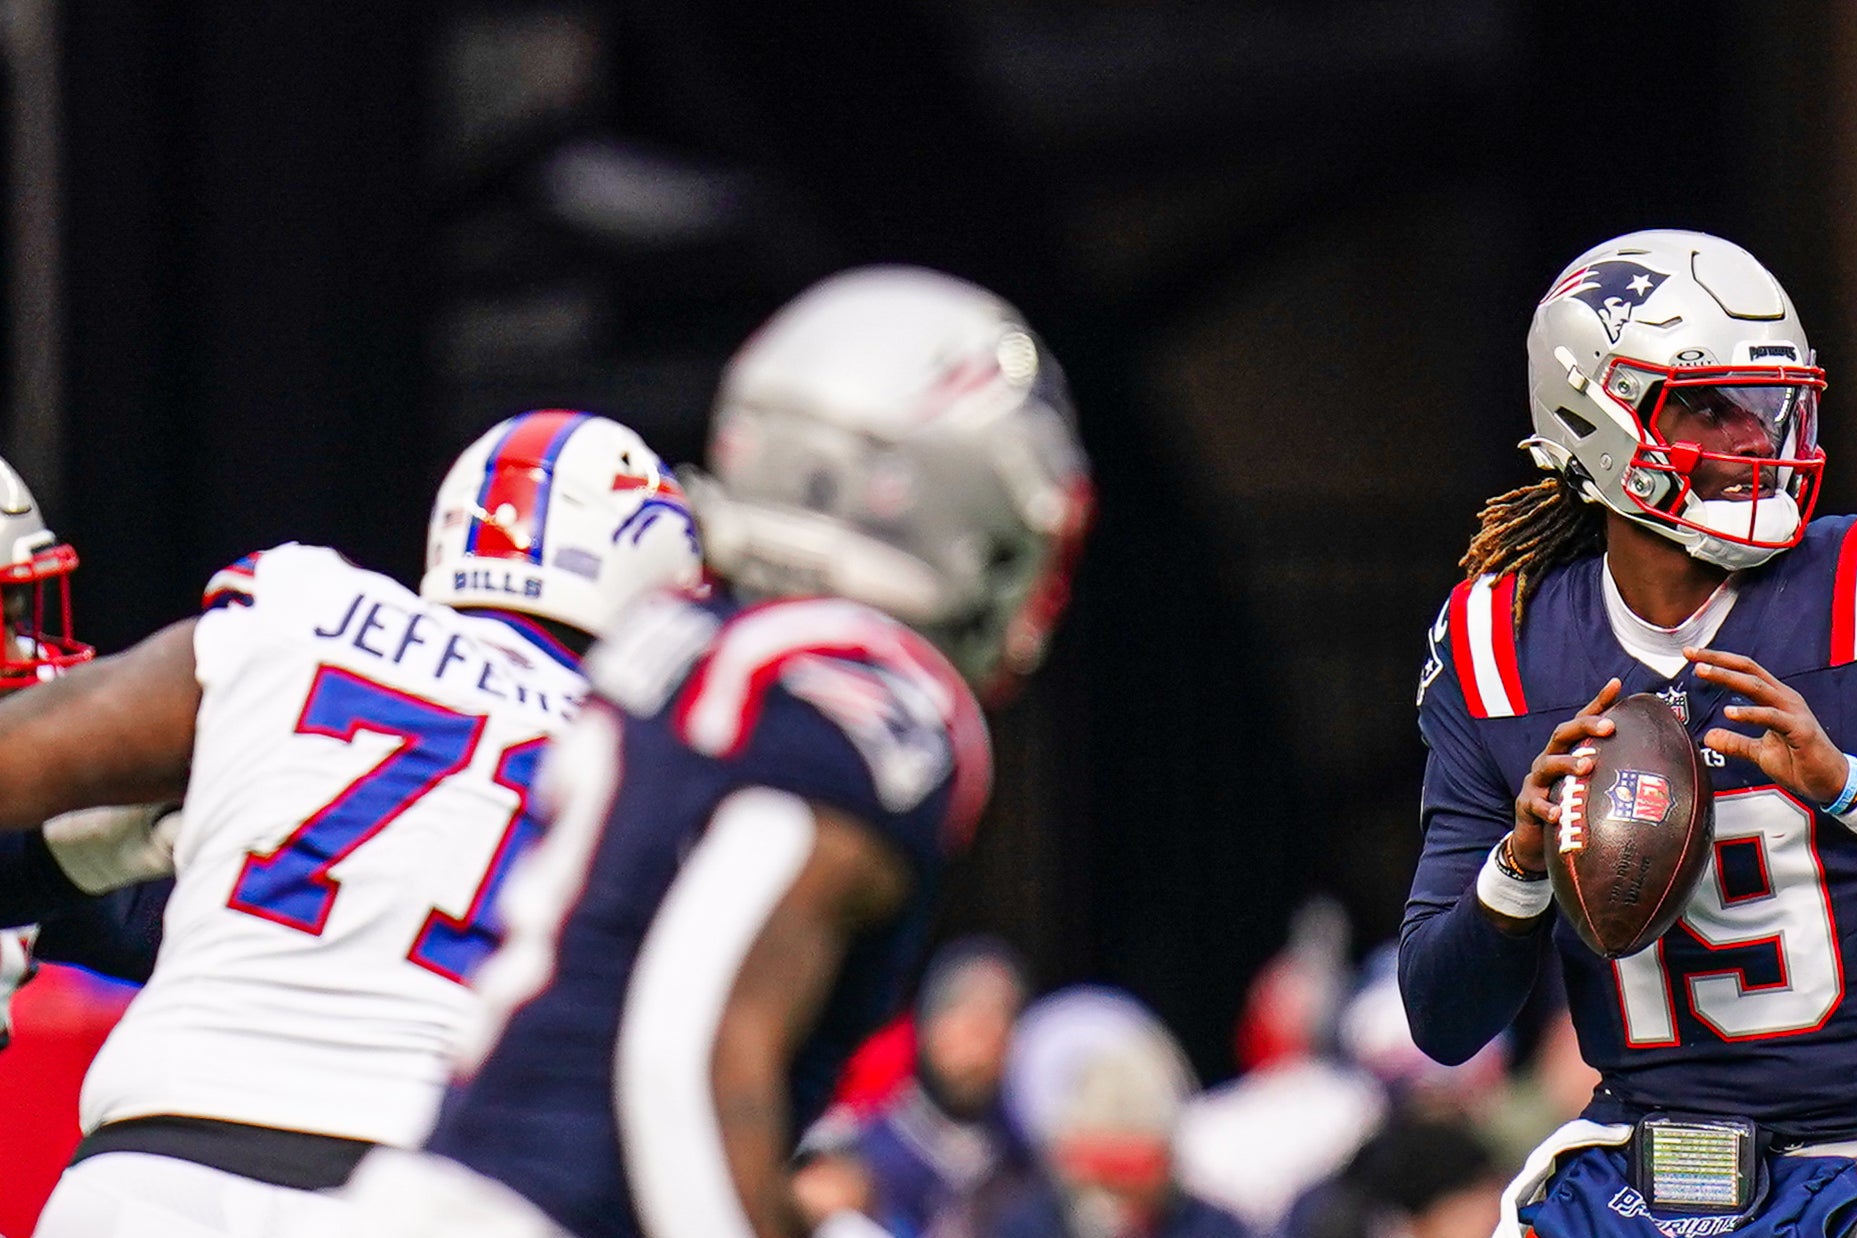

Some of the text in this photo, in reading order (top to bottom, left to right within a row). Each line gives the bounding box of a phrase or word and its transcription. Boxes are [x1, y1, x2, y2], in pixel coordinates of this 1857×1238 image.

[454, 570, 543, 598] BILLS
[313, 594, 584, 721] JEFFE
[1636, 779, 1670, 820] NFL
